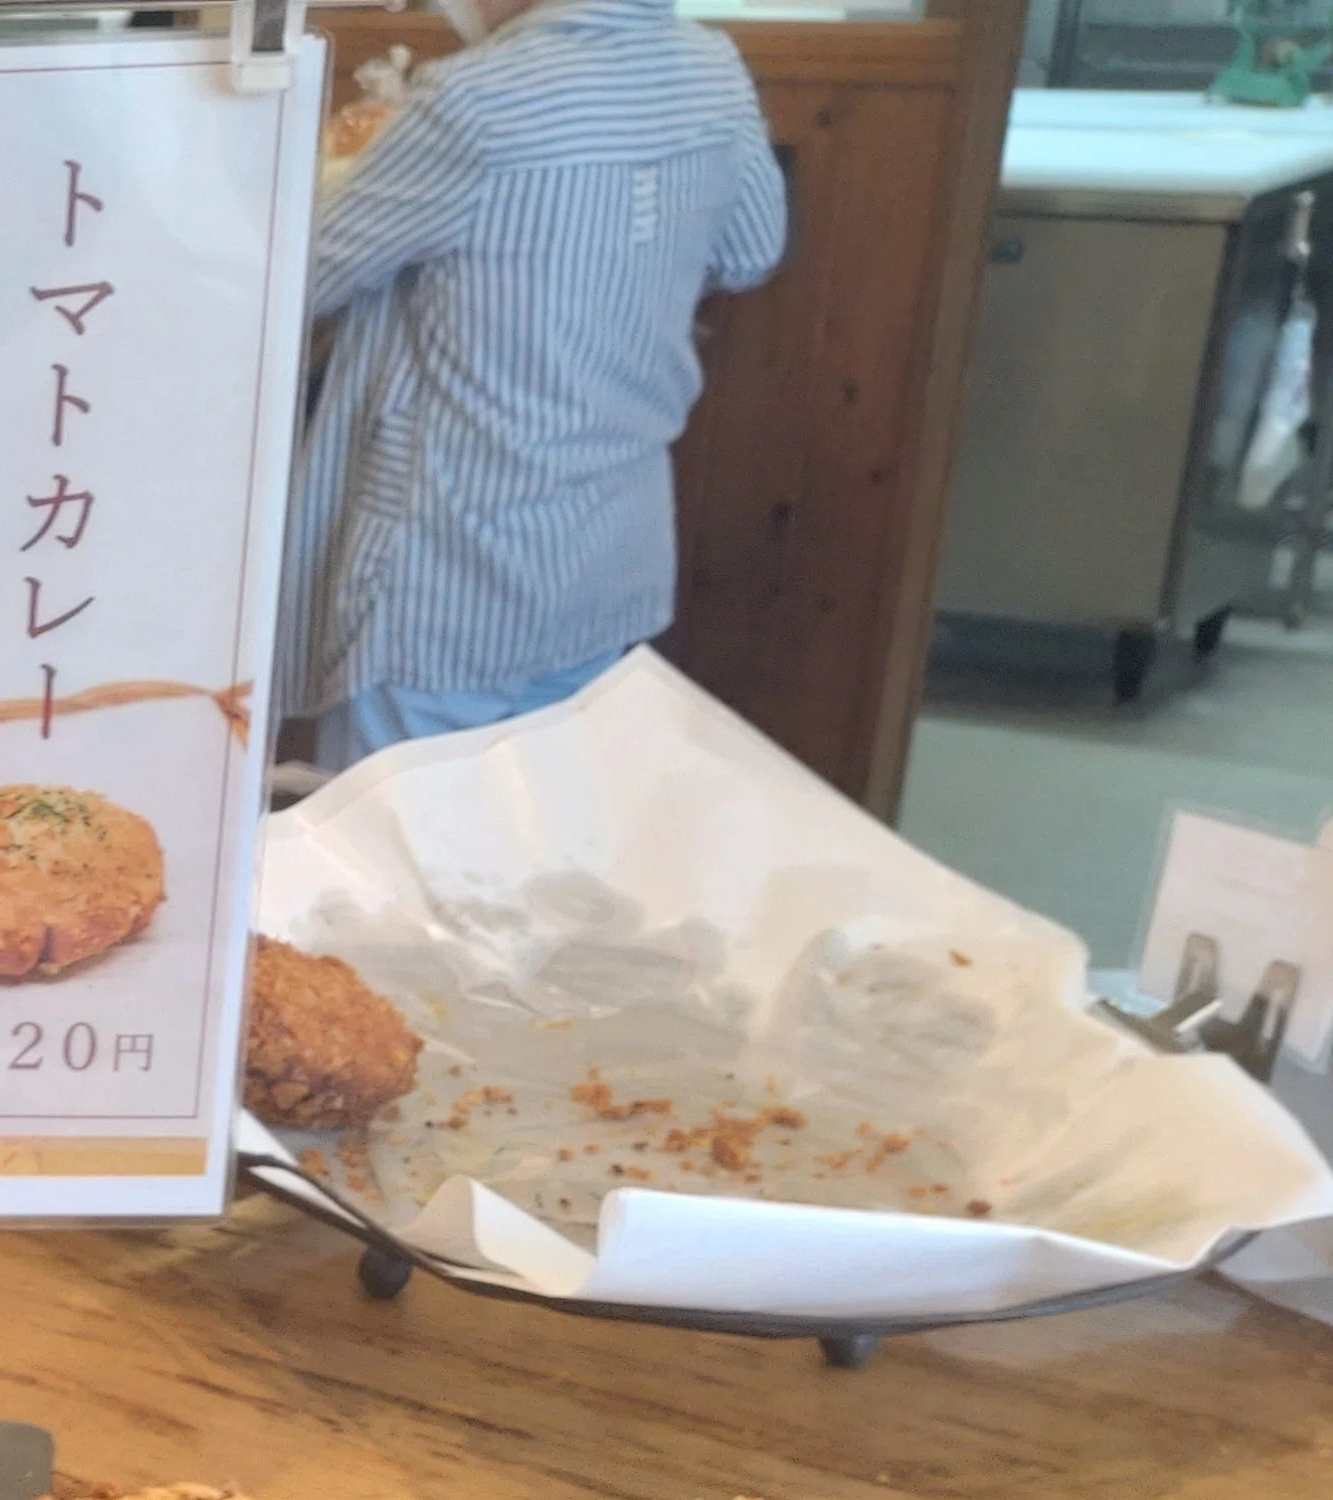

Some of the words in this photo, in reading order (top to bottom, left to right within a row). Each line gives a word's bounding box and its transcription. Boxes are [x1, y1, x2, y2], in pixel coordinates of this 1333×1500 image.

[20, 159, 115, 740] トマトカレー
